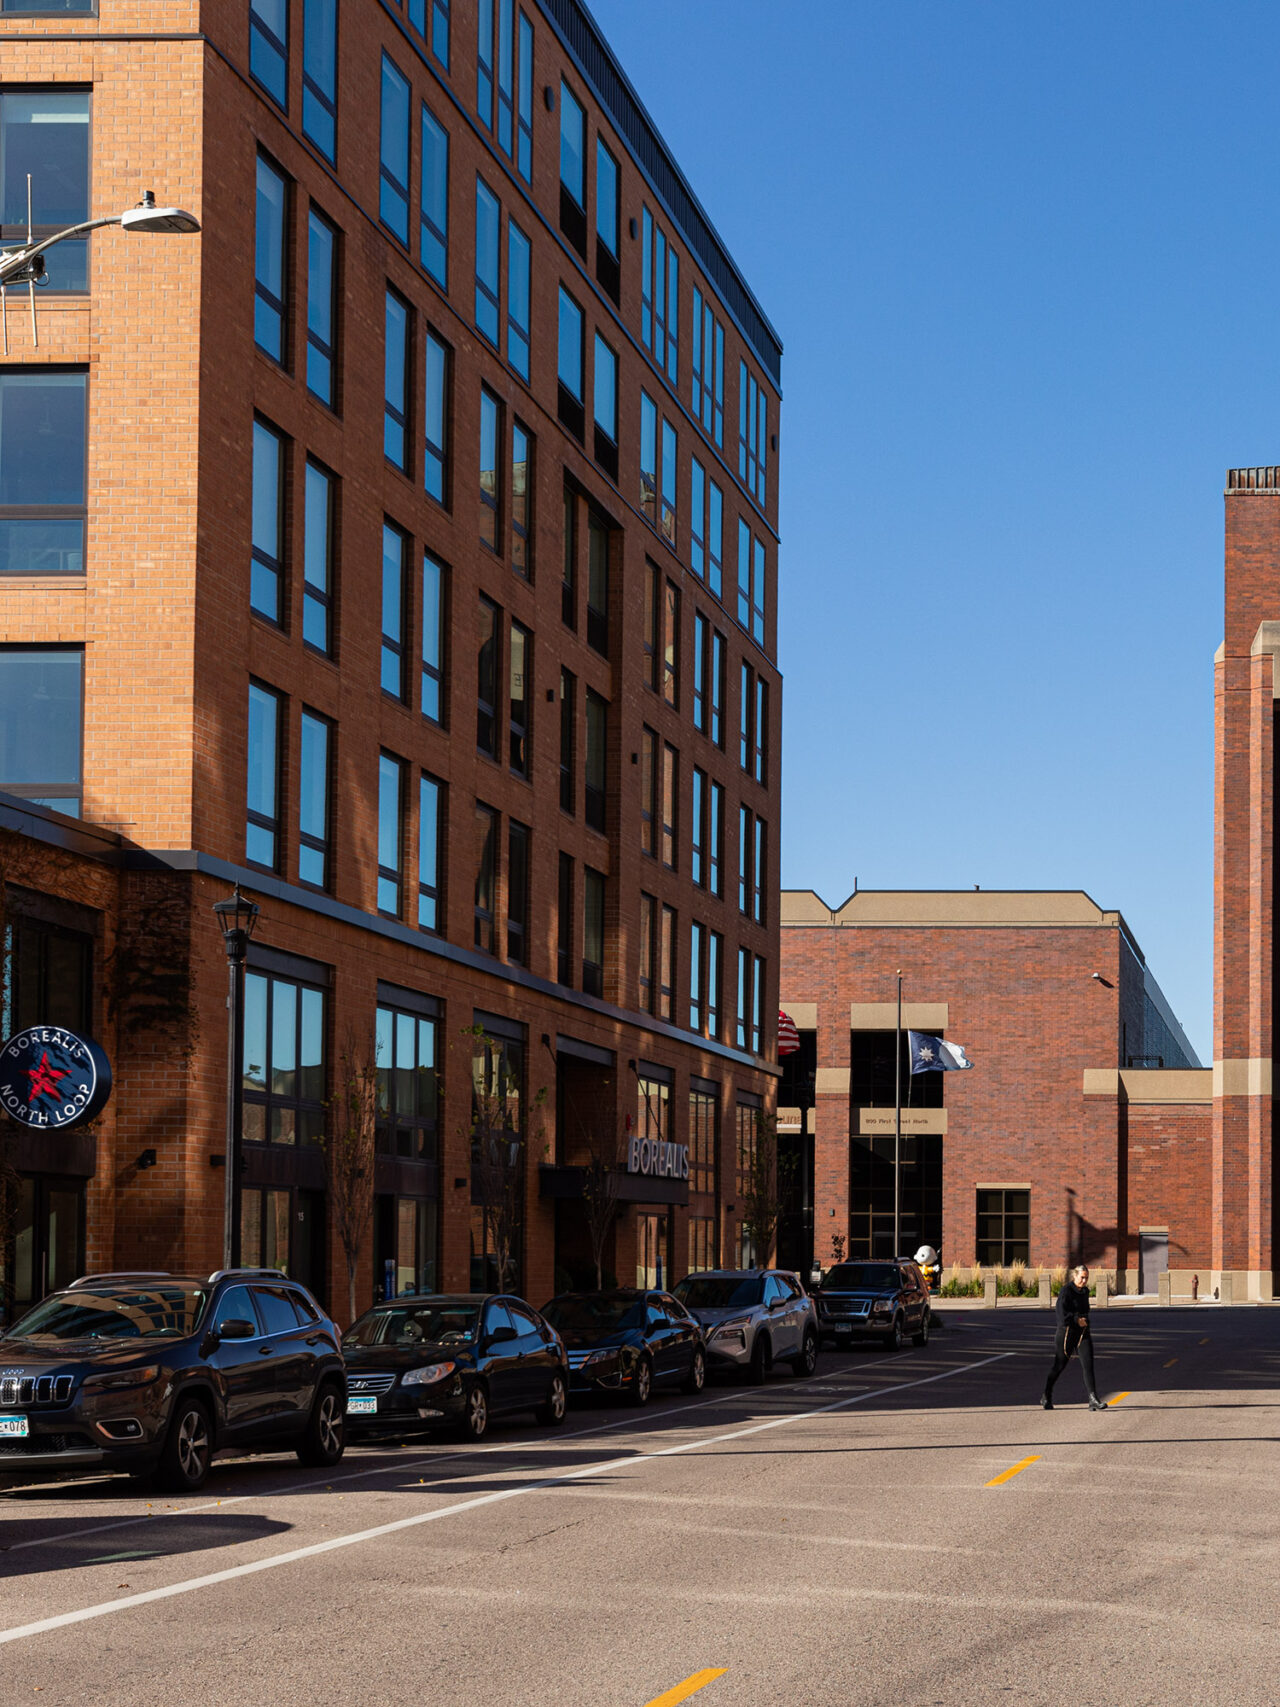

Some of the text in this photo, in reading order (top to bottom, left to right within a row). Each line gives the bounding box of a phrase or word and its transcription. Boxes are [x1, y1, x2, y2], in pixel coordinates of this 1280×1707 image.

[8, 1030, 85, 1058] BOREALIS
[1, 1084, 90, 1123] NORTH LOOP
[627, 1136, 689, 1180] BOREALIS
